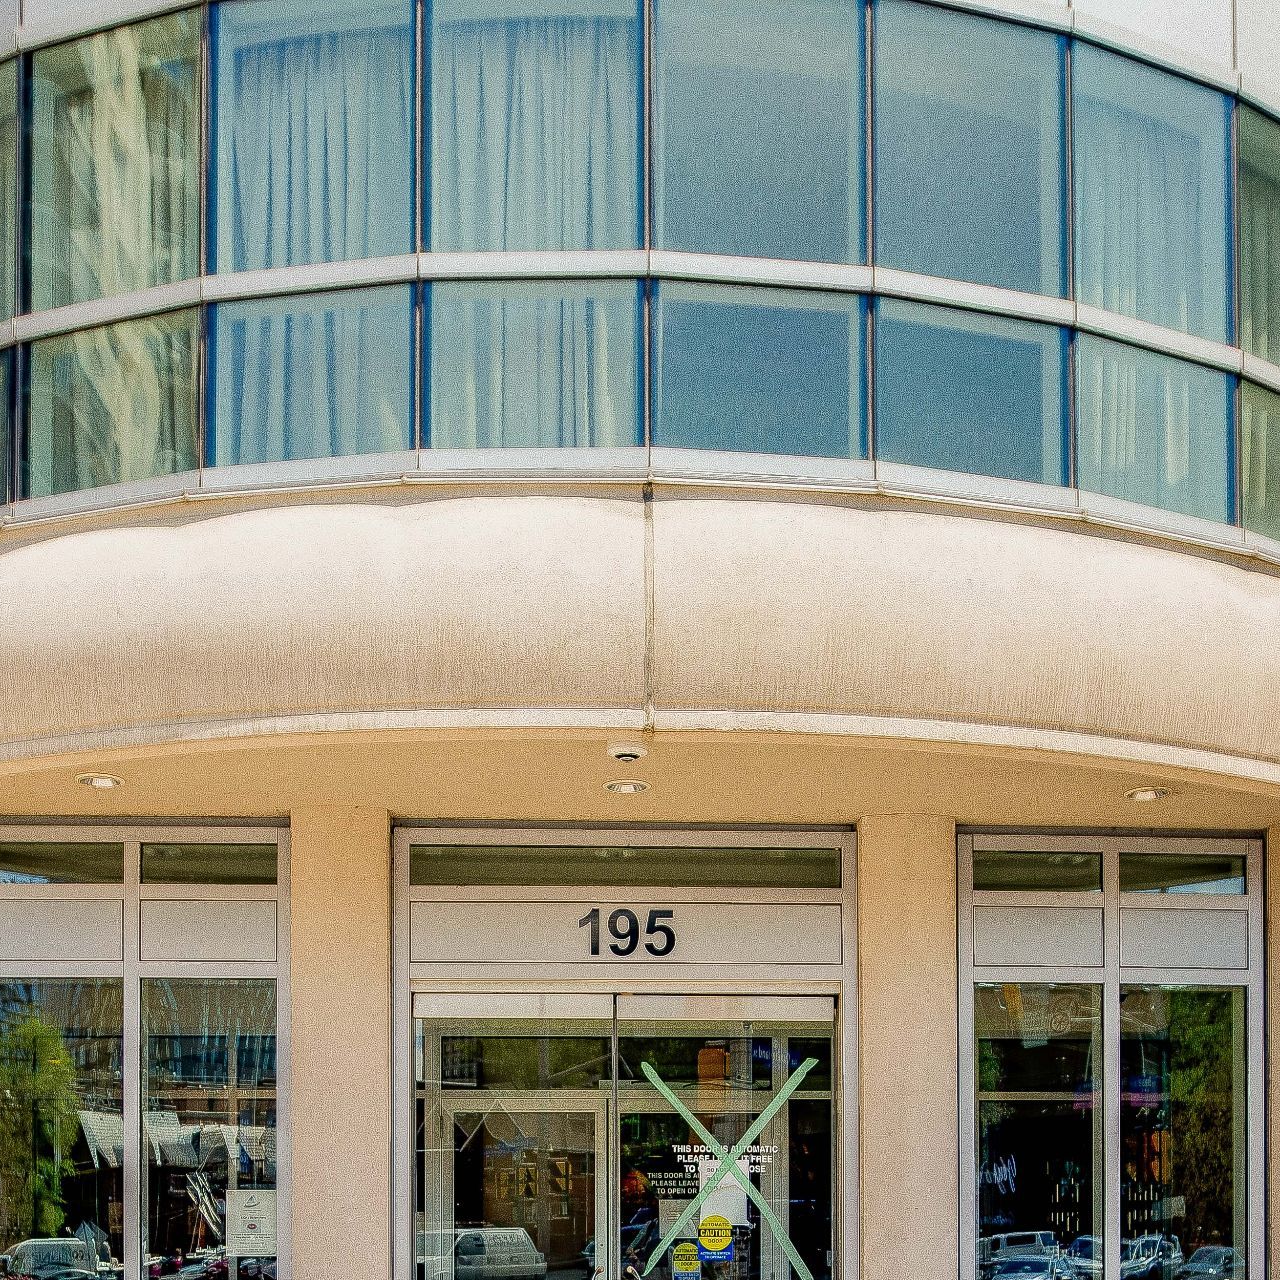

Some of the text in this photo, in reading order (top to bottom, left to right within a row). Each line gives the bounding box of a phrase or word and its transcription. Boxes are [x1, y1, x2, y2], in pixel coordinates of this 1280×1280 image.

[578, 907, 676, 957] 195
[672, 1144, 779, 1153] THIS DOOR IS AUTOMATIC
[677, 1154, 710, 1163] PLEASE
[750, 1155, 773, 1163] FREE
[683, 1165, 696, 1173] TO
[749, 1165, 766, 1173] OSE
[700, 1229, 731, 1237] CAUTION
